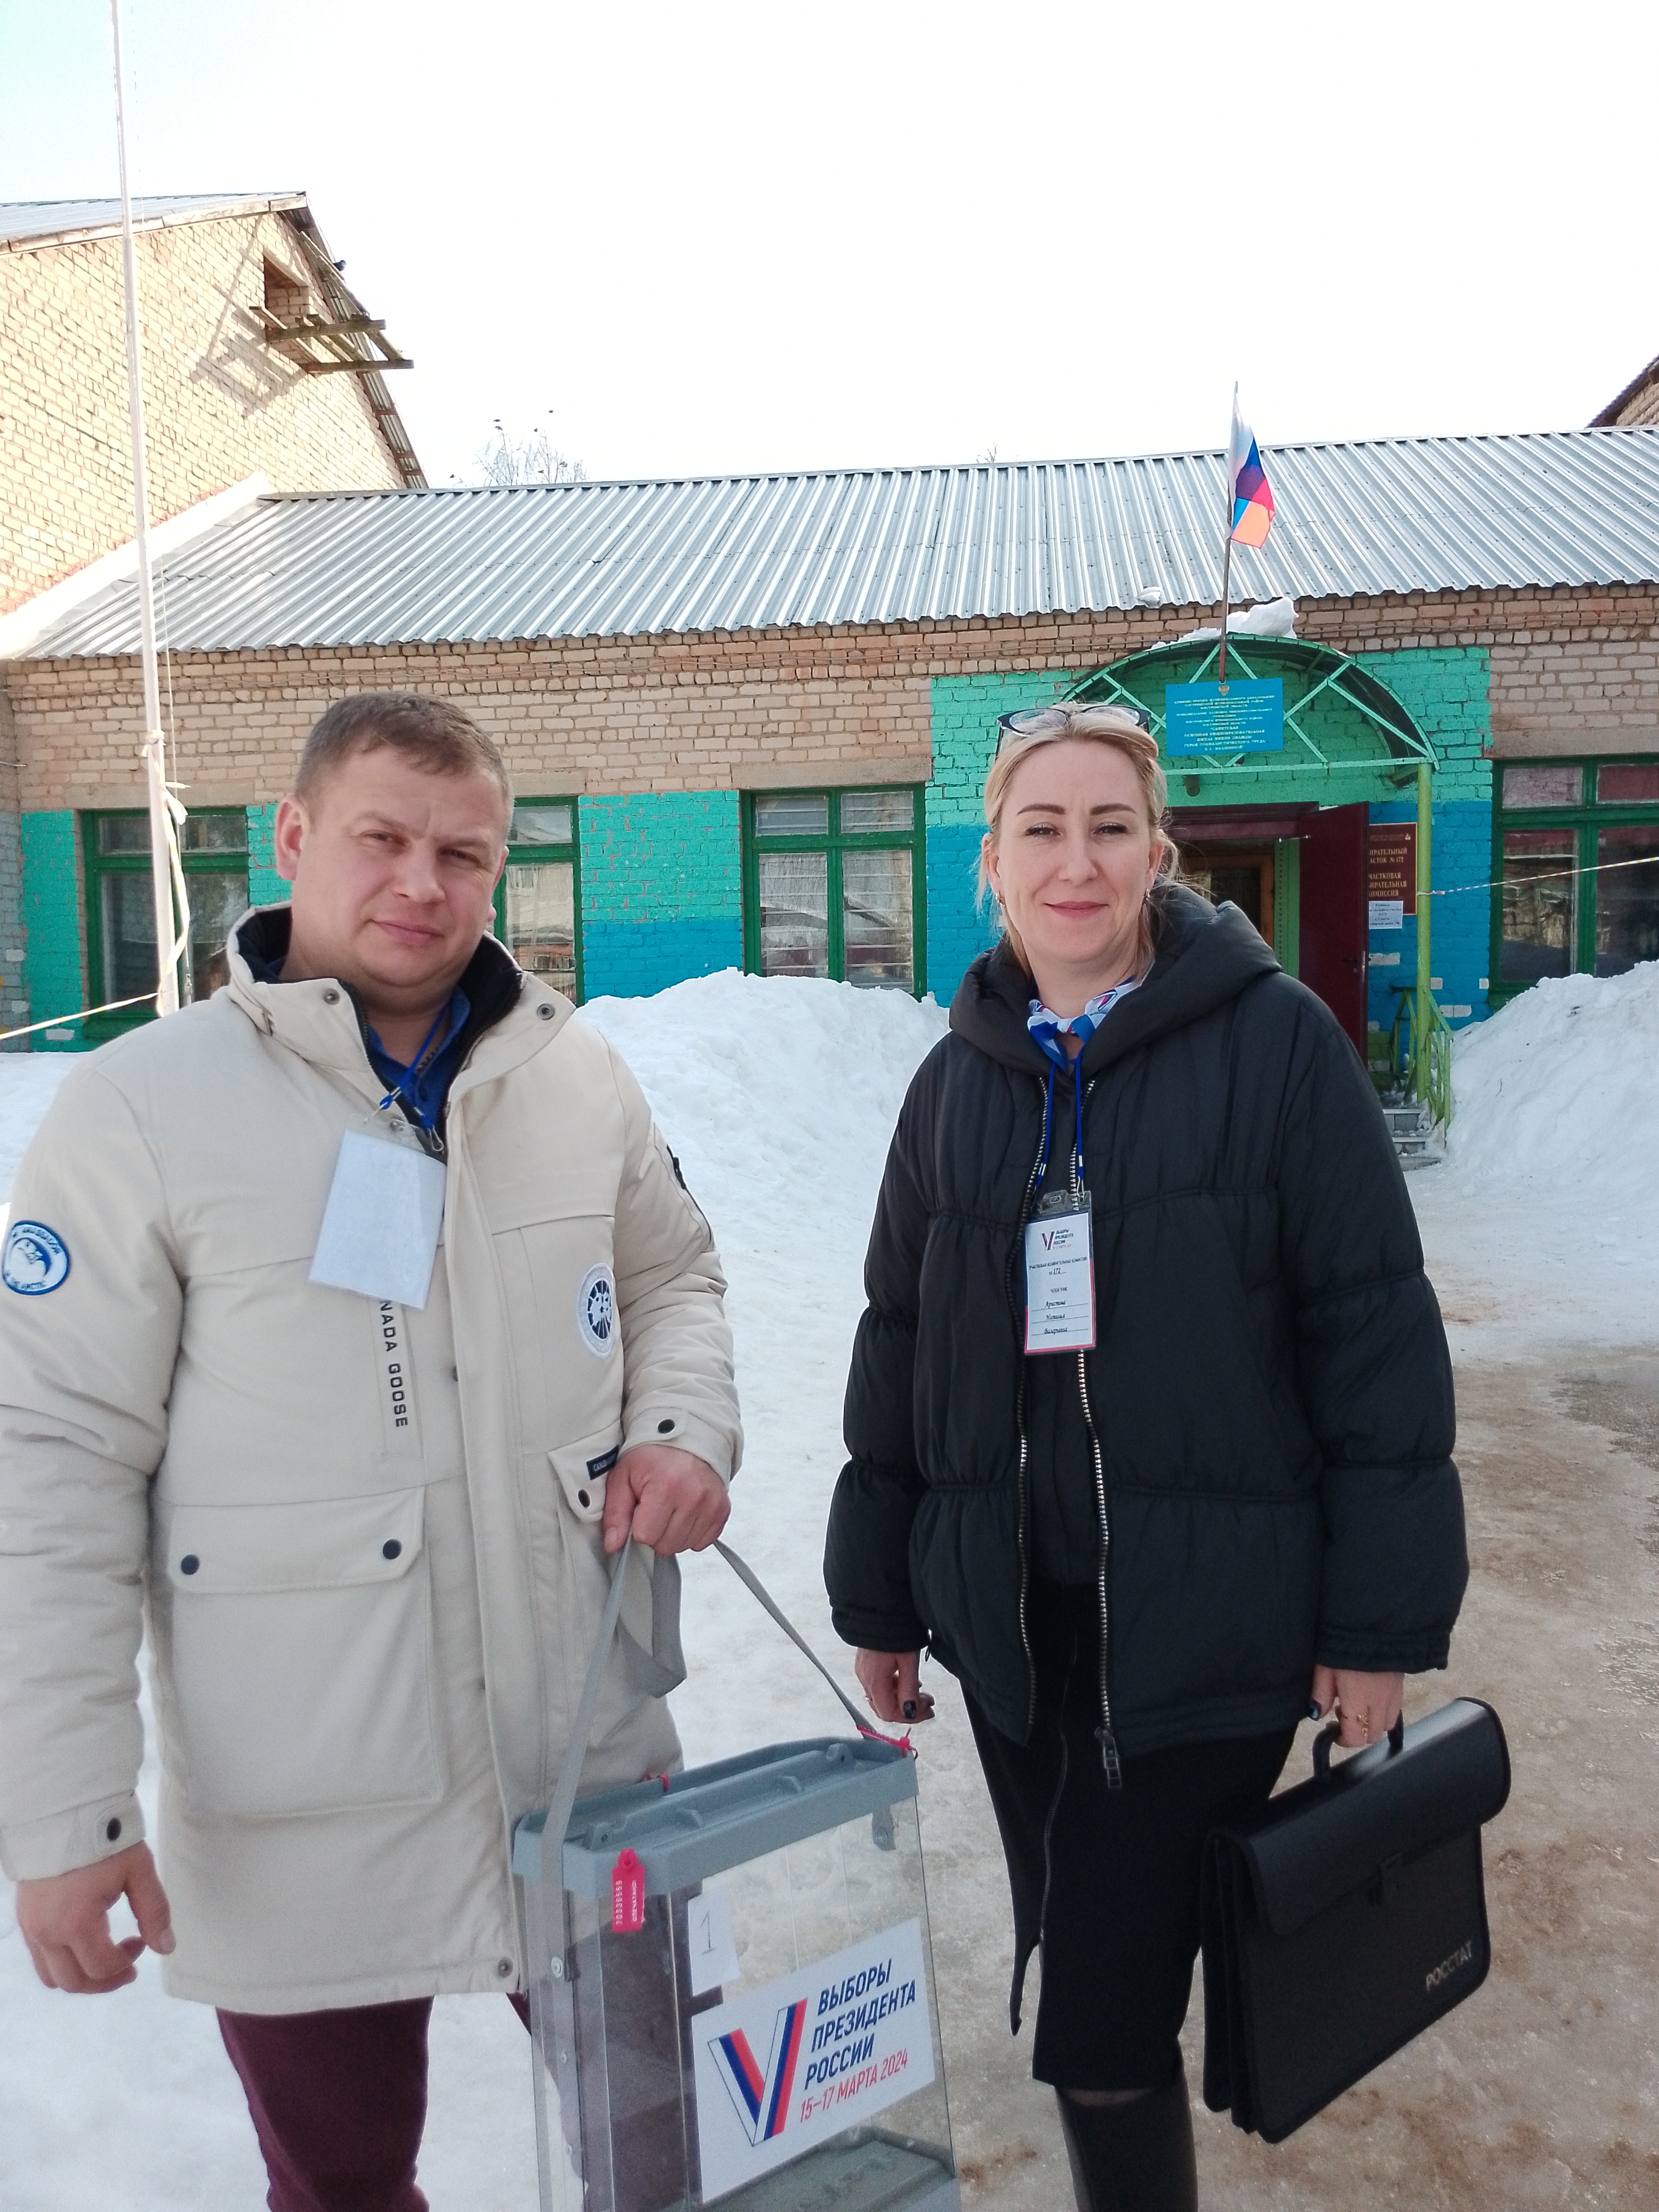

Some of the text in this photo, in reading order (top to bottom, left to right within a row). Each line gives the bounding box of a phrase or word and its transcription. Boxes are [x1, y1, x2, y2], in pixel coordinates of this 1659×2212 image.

[1369, 847, 1407, 856] ИРАТЕЛЬНЫЙ
[380, 1300, 408, 1427] NADA GOOSE
[700, 1910, 717, 1956] 1
[810, 1979, 916, 2053] ПРЕЗИДЕНТА
[817, 1958, 893, 2016] ВЫБОРЫ
[804, 2033, 876, 2090] РОССИИ
[836, 2064, 879, 2106] МАРТА
[879, 2048, 908, 2082] 2024
